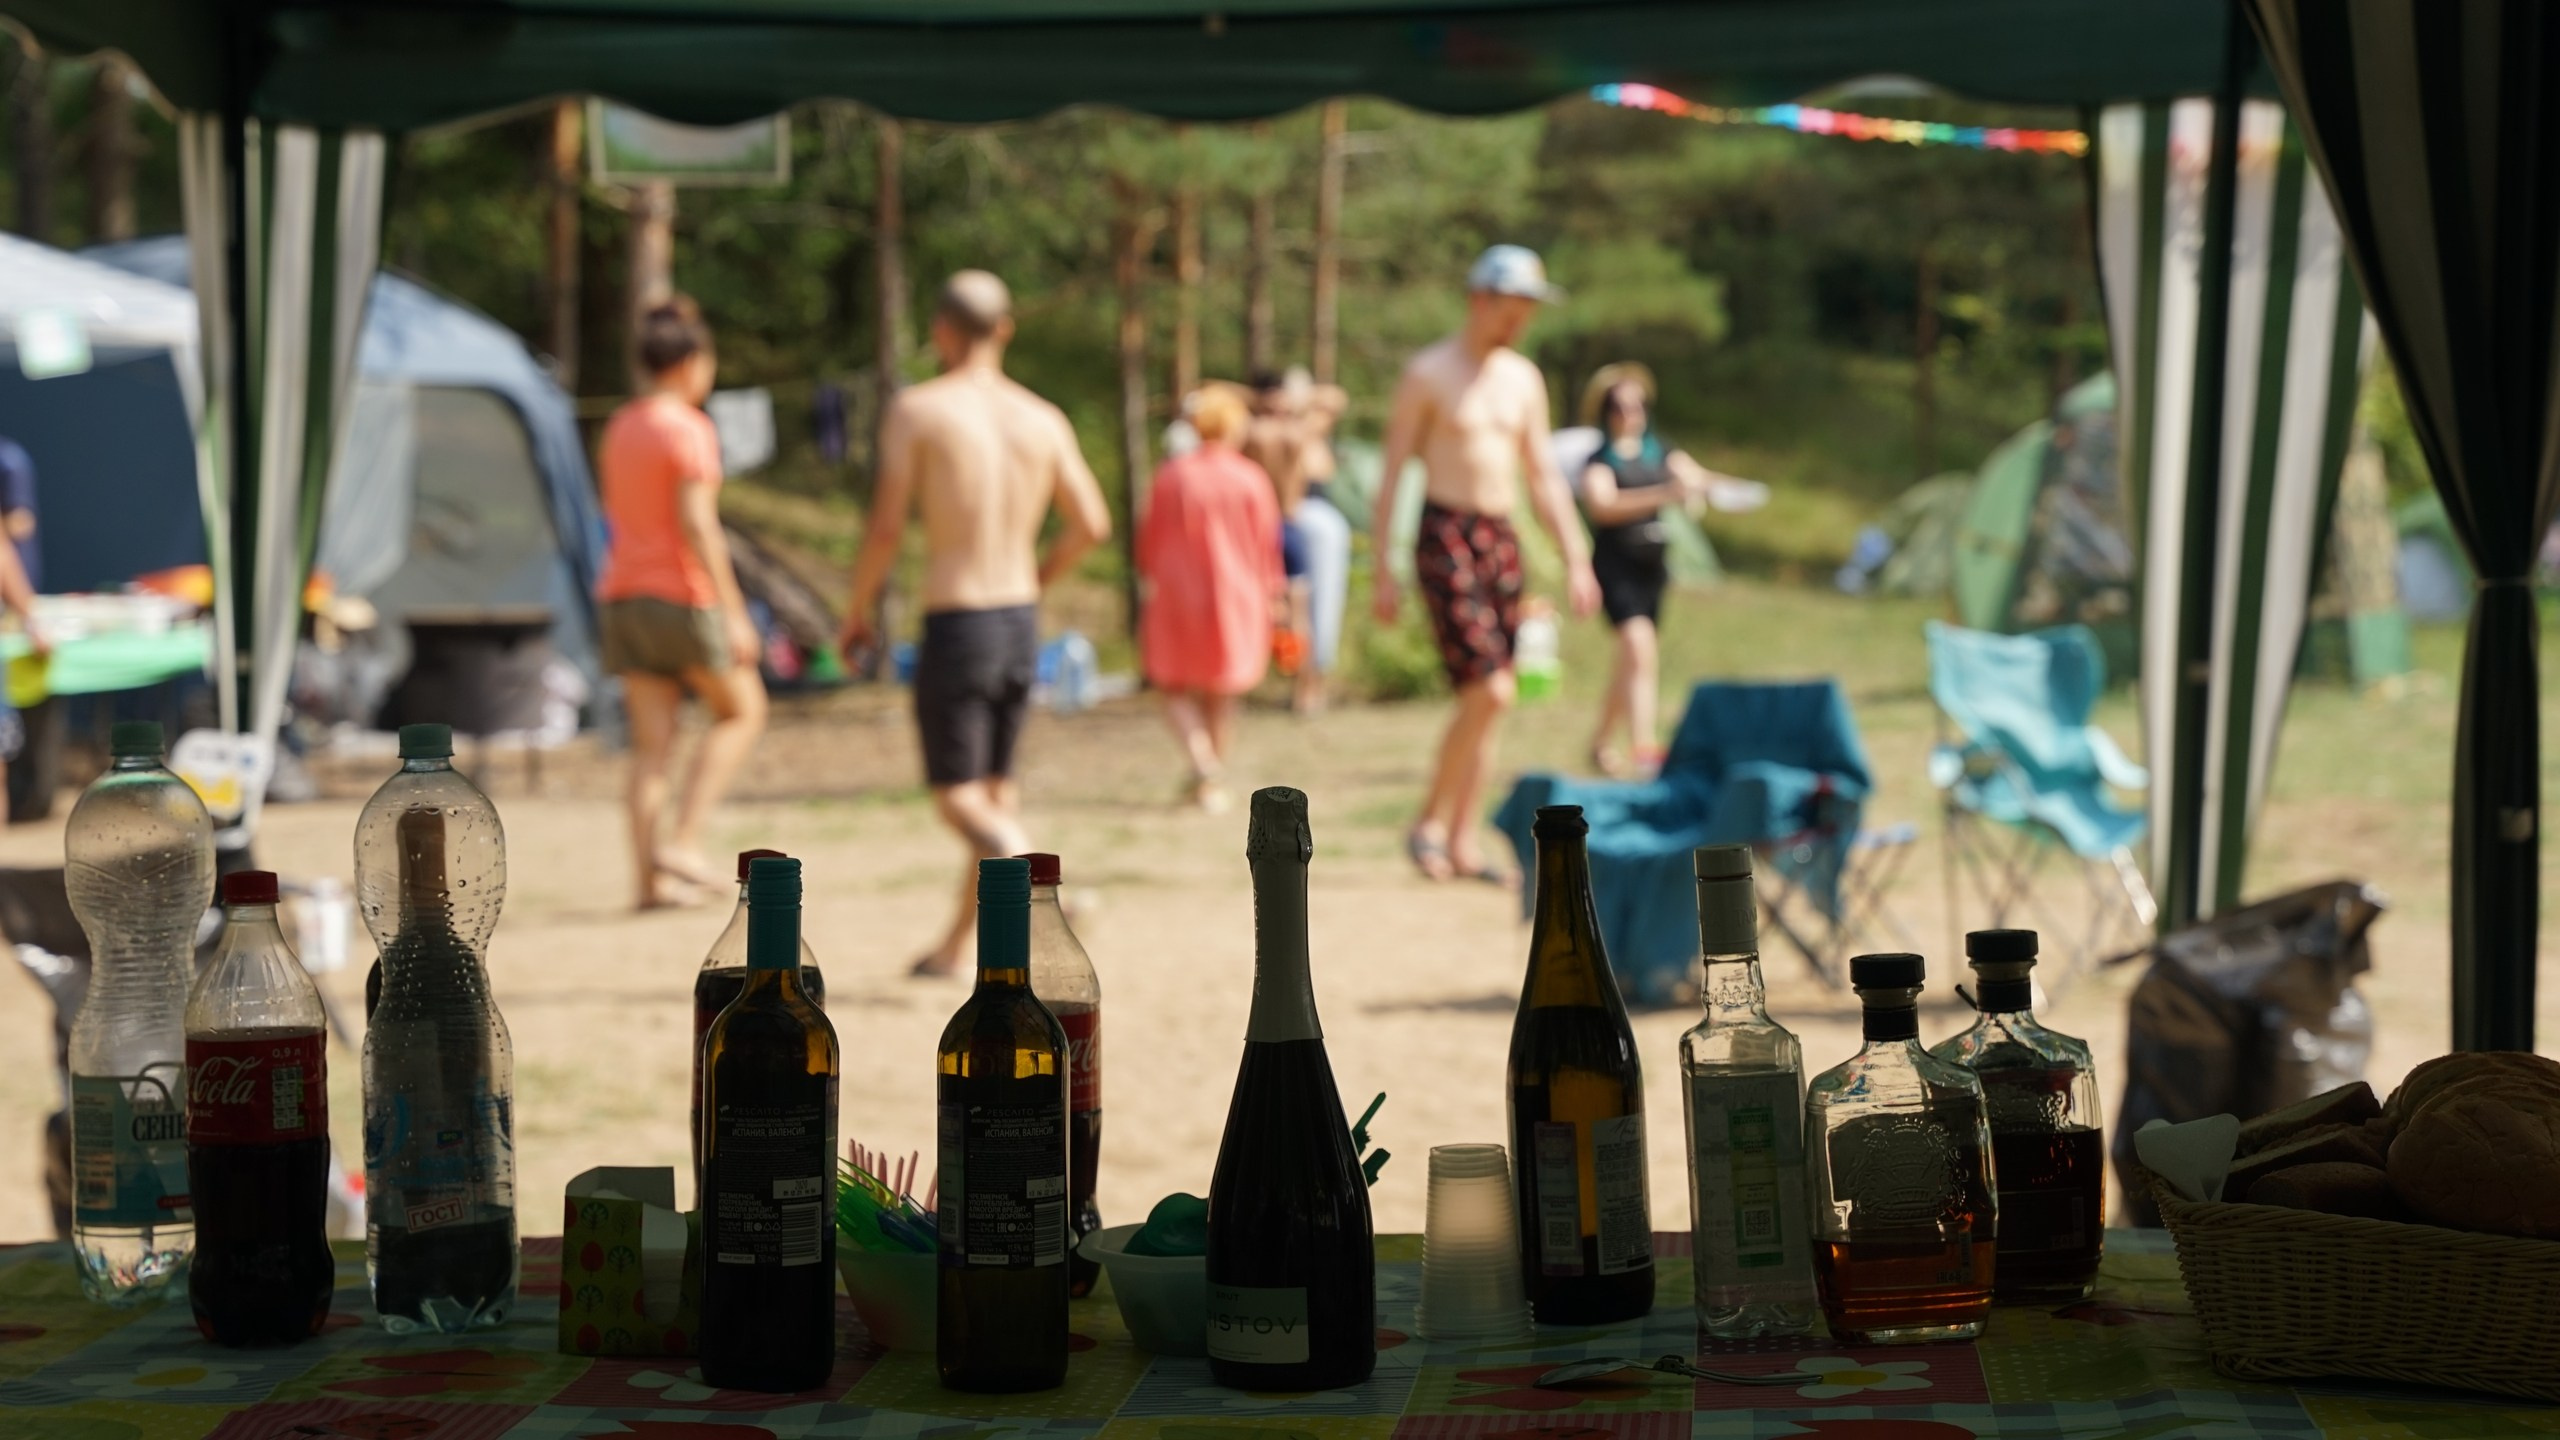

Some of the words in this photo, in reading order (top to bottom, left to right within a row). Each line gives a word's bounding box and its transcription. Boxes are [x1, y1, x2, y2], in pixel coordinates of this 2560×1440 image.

[768, 1126, 806, 1137] ВАЛЕНСИЯ
[411, 1203, 458, 1227] ГОСТ
[1216, 1291, 1240, 1301] BRUT
